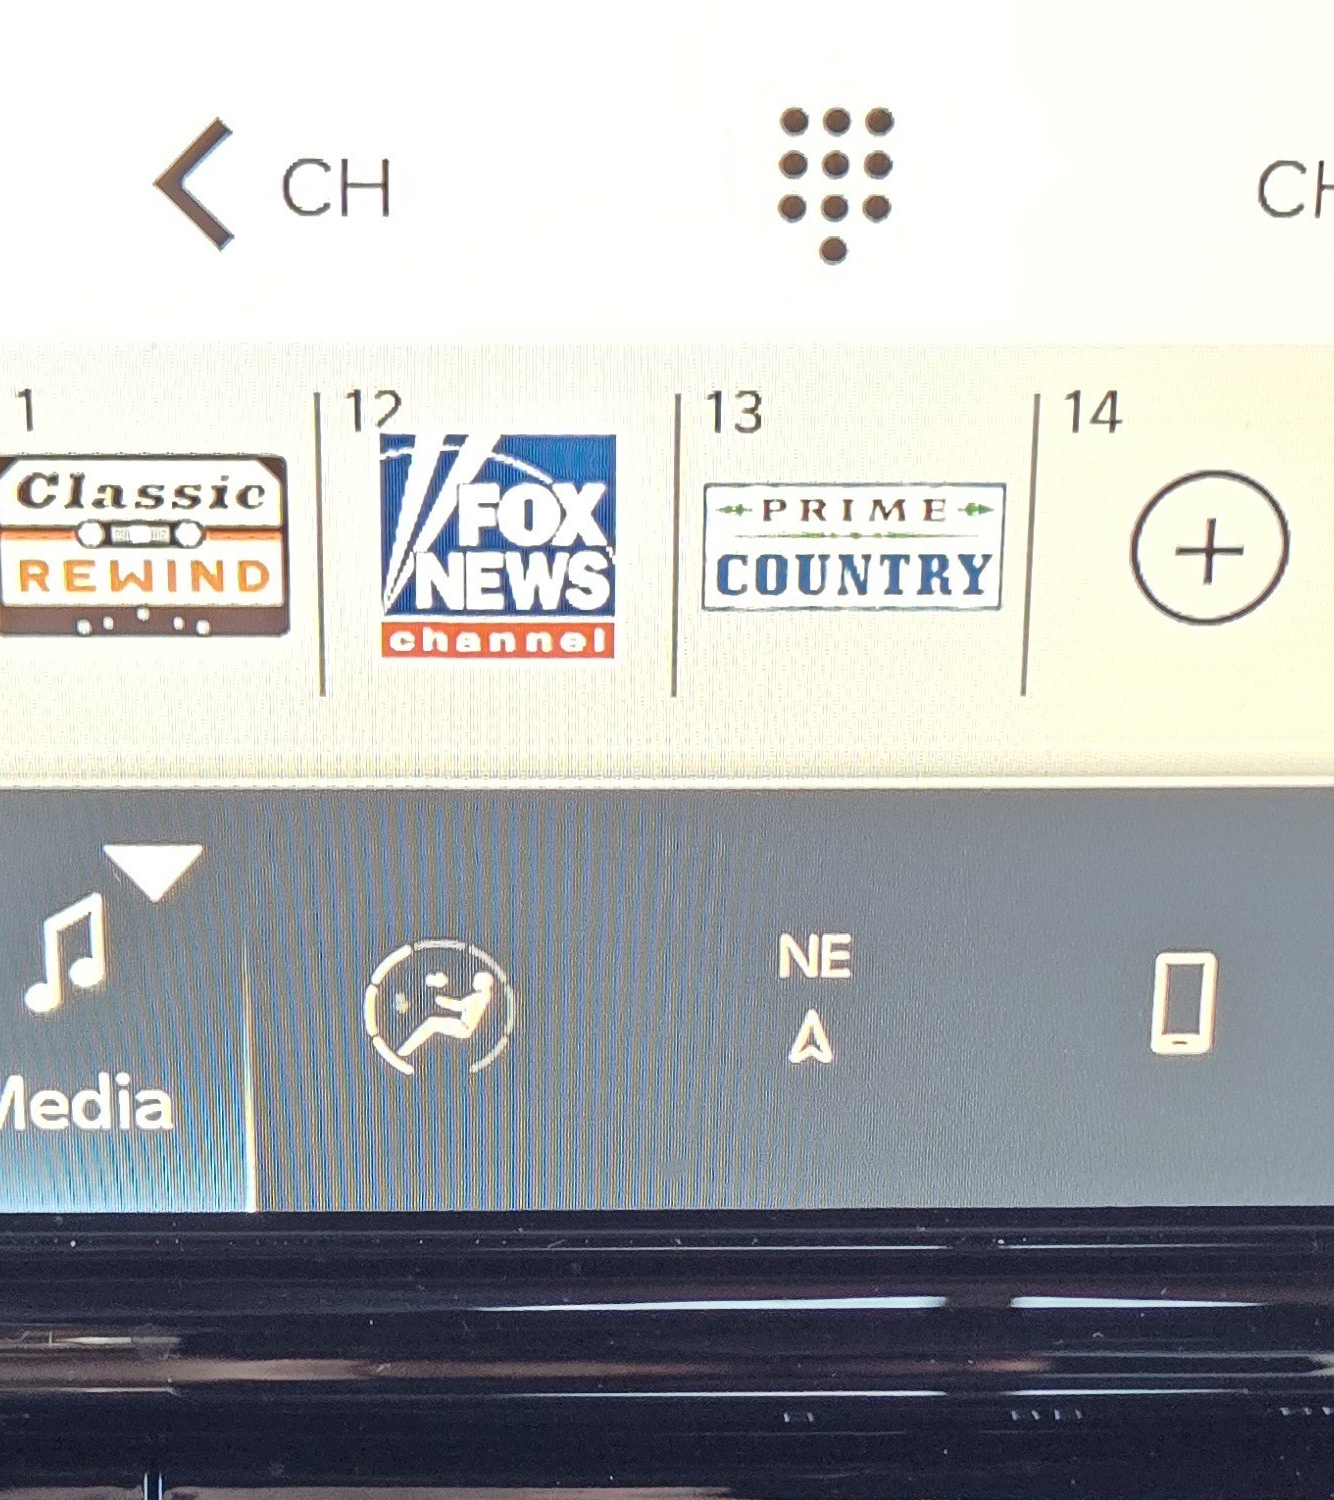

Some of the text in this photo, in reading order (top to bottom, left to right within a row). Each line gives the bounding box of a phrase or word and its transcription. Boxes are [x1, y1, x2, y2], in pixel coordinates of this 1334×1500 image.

[282, 157, 390, 218] CH
[345, 388, 403, 432] 12
[705, 389, 765, 434] 13
[1064, 389, 1123, 434] 14
[17, 470, 267, 512] Classic
[760, 498, 952, 522] PRIME
[458, 480, 606, 548] FOX
[17, 558, 270, 593] REWIND
[415, 550, 611, 613] NEWS
[715, 553, 992, 599] COUNTRY
[389, 626, 609, 655] channel
[777, 934, 853, 980] NE
